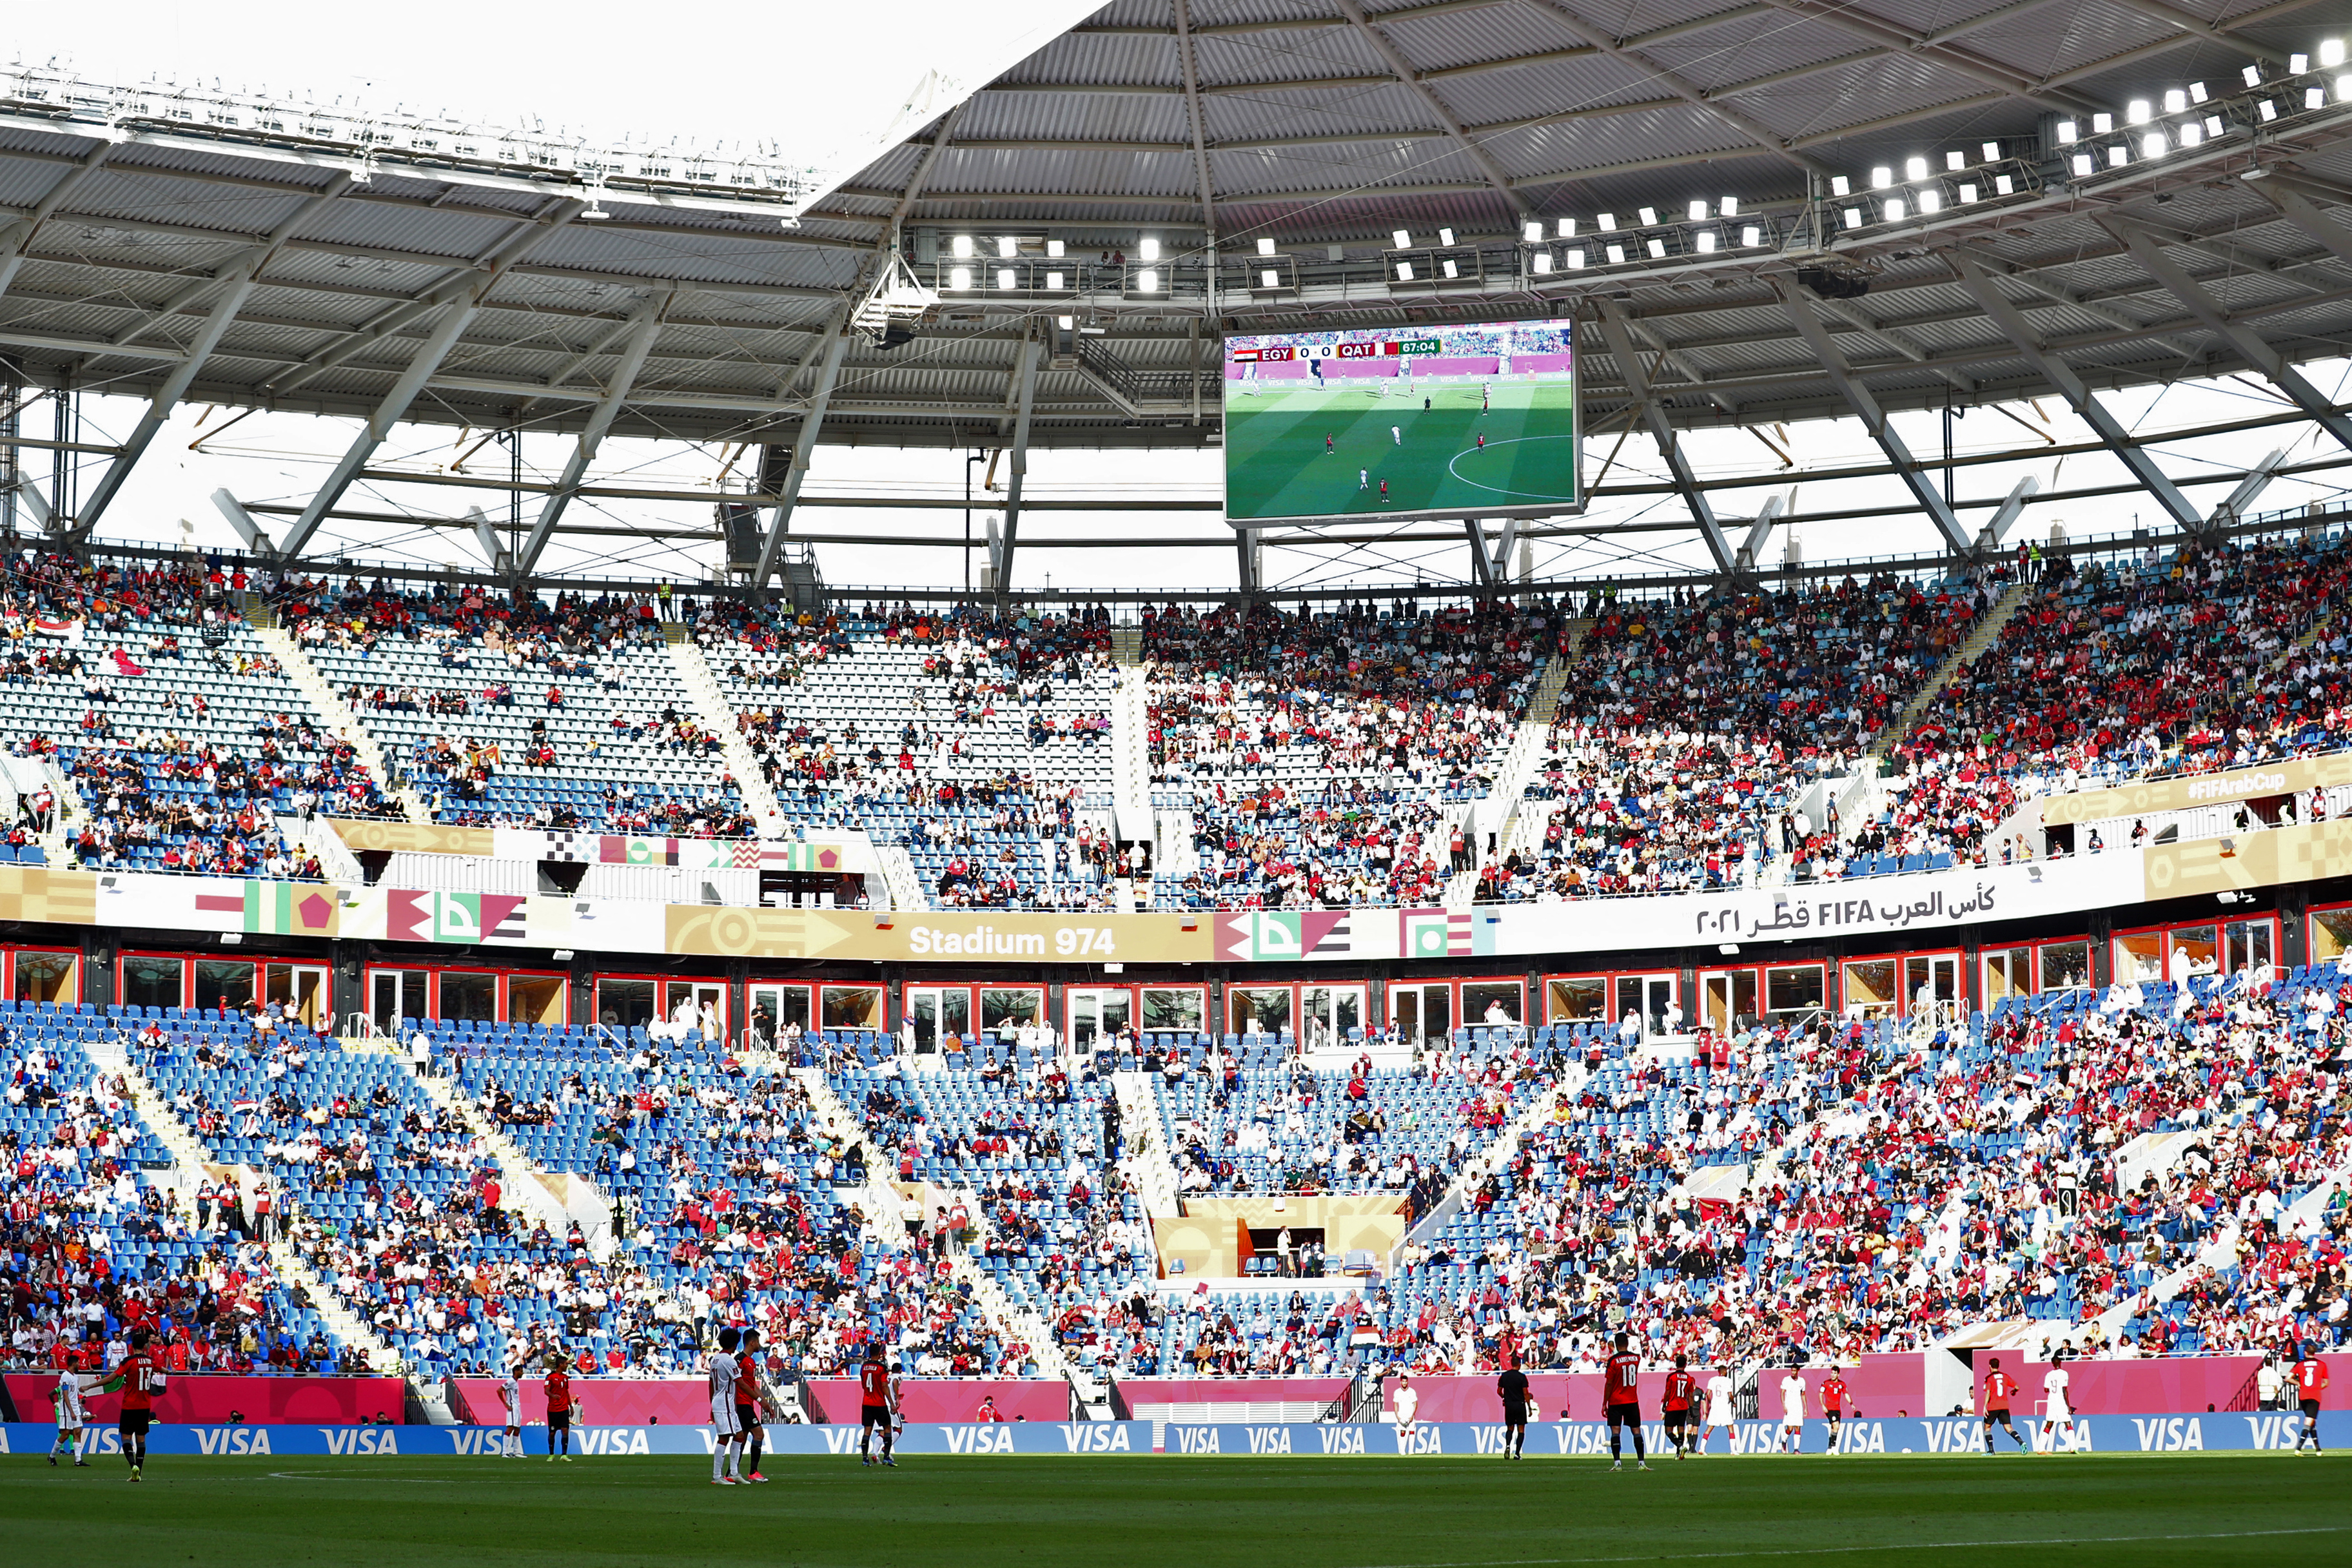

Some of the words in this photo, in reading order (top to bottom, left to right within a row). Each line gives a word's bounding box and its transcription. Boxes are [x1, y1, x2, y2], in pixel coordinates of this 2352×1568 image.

[1262, 349, 1289, 360] EGY
[1300, 348, 1309, 358] 0
[1322, 347, 1331, 357] 0
[1342, 344, 1371, 357] QAT
[1402, 341, 1436, 353] 67:04
[2188, 772, 2286, 799] #FIFArabCup
[1819, 899, 1875, 926] FIFA
[1881, 891, 1943, 926] العرب
[1948, 881, 1995, 919] كأس
[1747, 900, 1810, 937] قطر
[910, 925, 1045, 954] Stadium
[1055, 928, 1115, 956] 974
[139, 1367, 153, 1391] 13
[866, 1373, 874, 1393] 4
[1622, 1364, 1636, 1387] 18
[1677, 1380, 1688, 1398] 17
[1996, 1378, 2004, 1397] 5
[2304, 1367, 2315, 1387] 3
[1715, 1384, 1722, 1398] 6
[190, 1428, 271, 1455] VISA
[318, 1428, 399, 1455] VISA
[570, 1429, 650, 1455] VISA
[818, 1427, 896, 1454] VIS
[939, 1426, 1015, 1453] VISA
[1057, 1424, 1131, 1451] VISA
[1175, 1427, 1220, 1453] VISA
[1245, 1427, 1293, 1453] VISA
[1317, 1427, 1366, 1453] VISA
[1553, 1425, 1611, 1454] VISA
[1920, 1420, 1986, 1452] VISA
[2131, 1417, 2203, 1451] VISA
